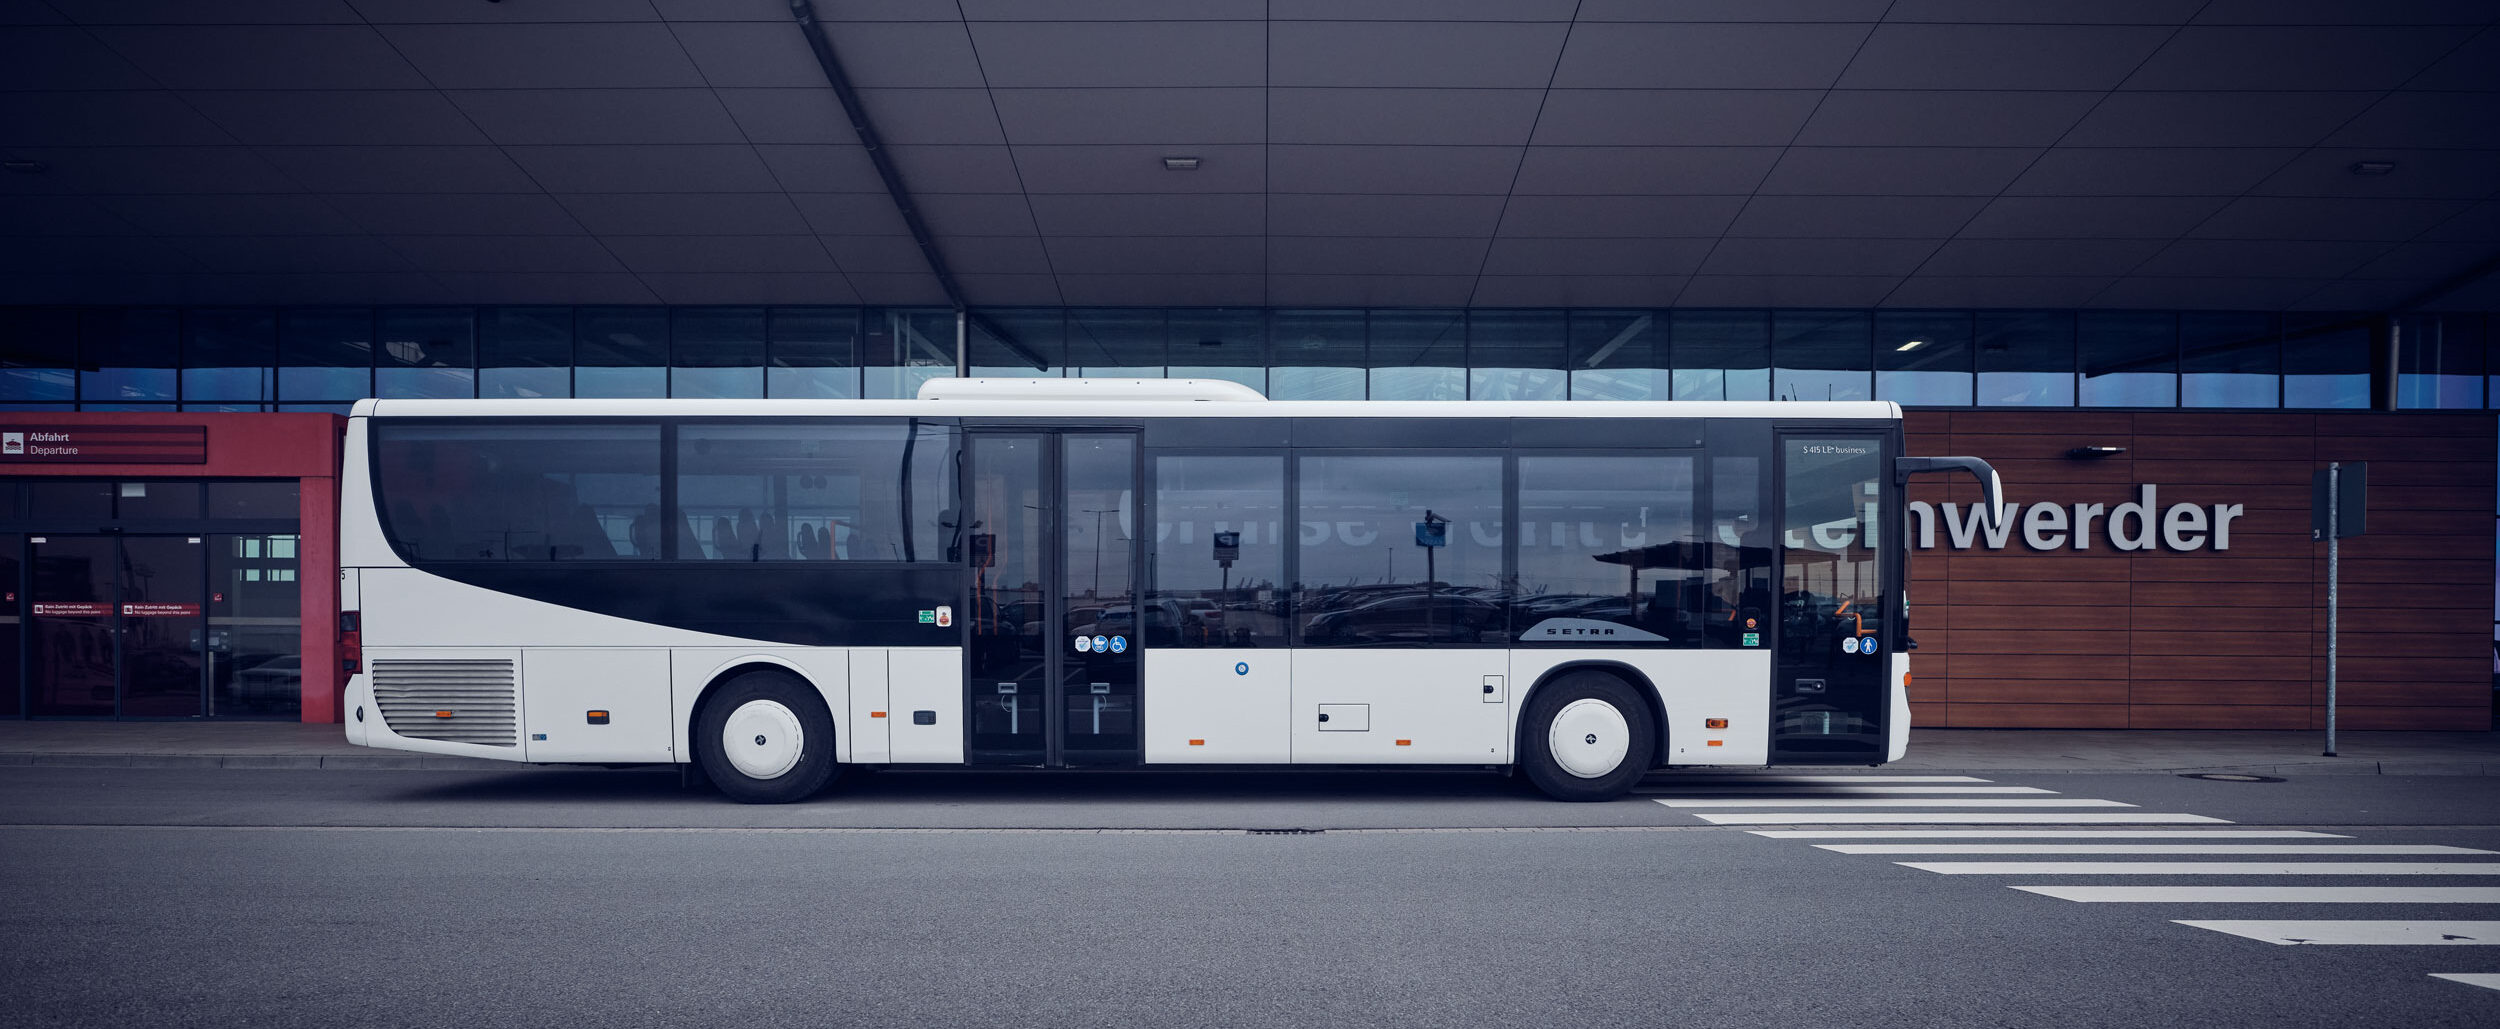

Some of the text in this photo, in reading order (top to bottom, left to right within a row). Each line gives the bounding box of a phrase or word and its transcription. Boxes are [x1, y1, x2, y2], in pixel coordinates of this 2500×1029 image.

[30, 432, 70, 442] Abfahrt
[30, 445, 79, 457] Departure
[1803, 446, 1808, 454] S
[1809, 446, 1821, 454] 415
[1835, 446, 1866, 454] business
[1717, 482, 2244, 551] einwerder
